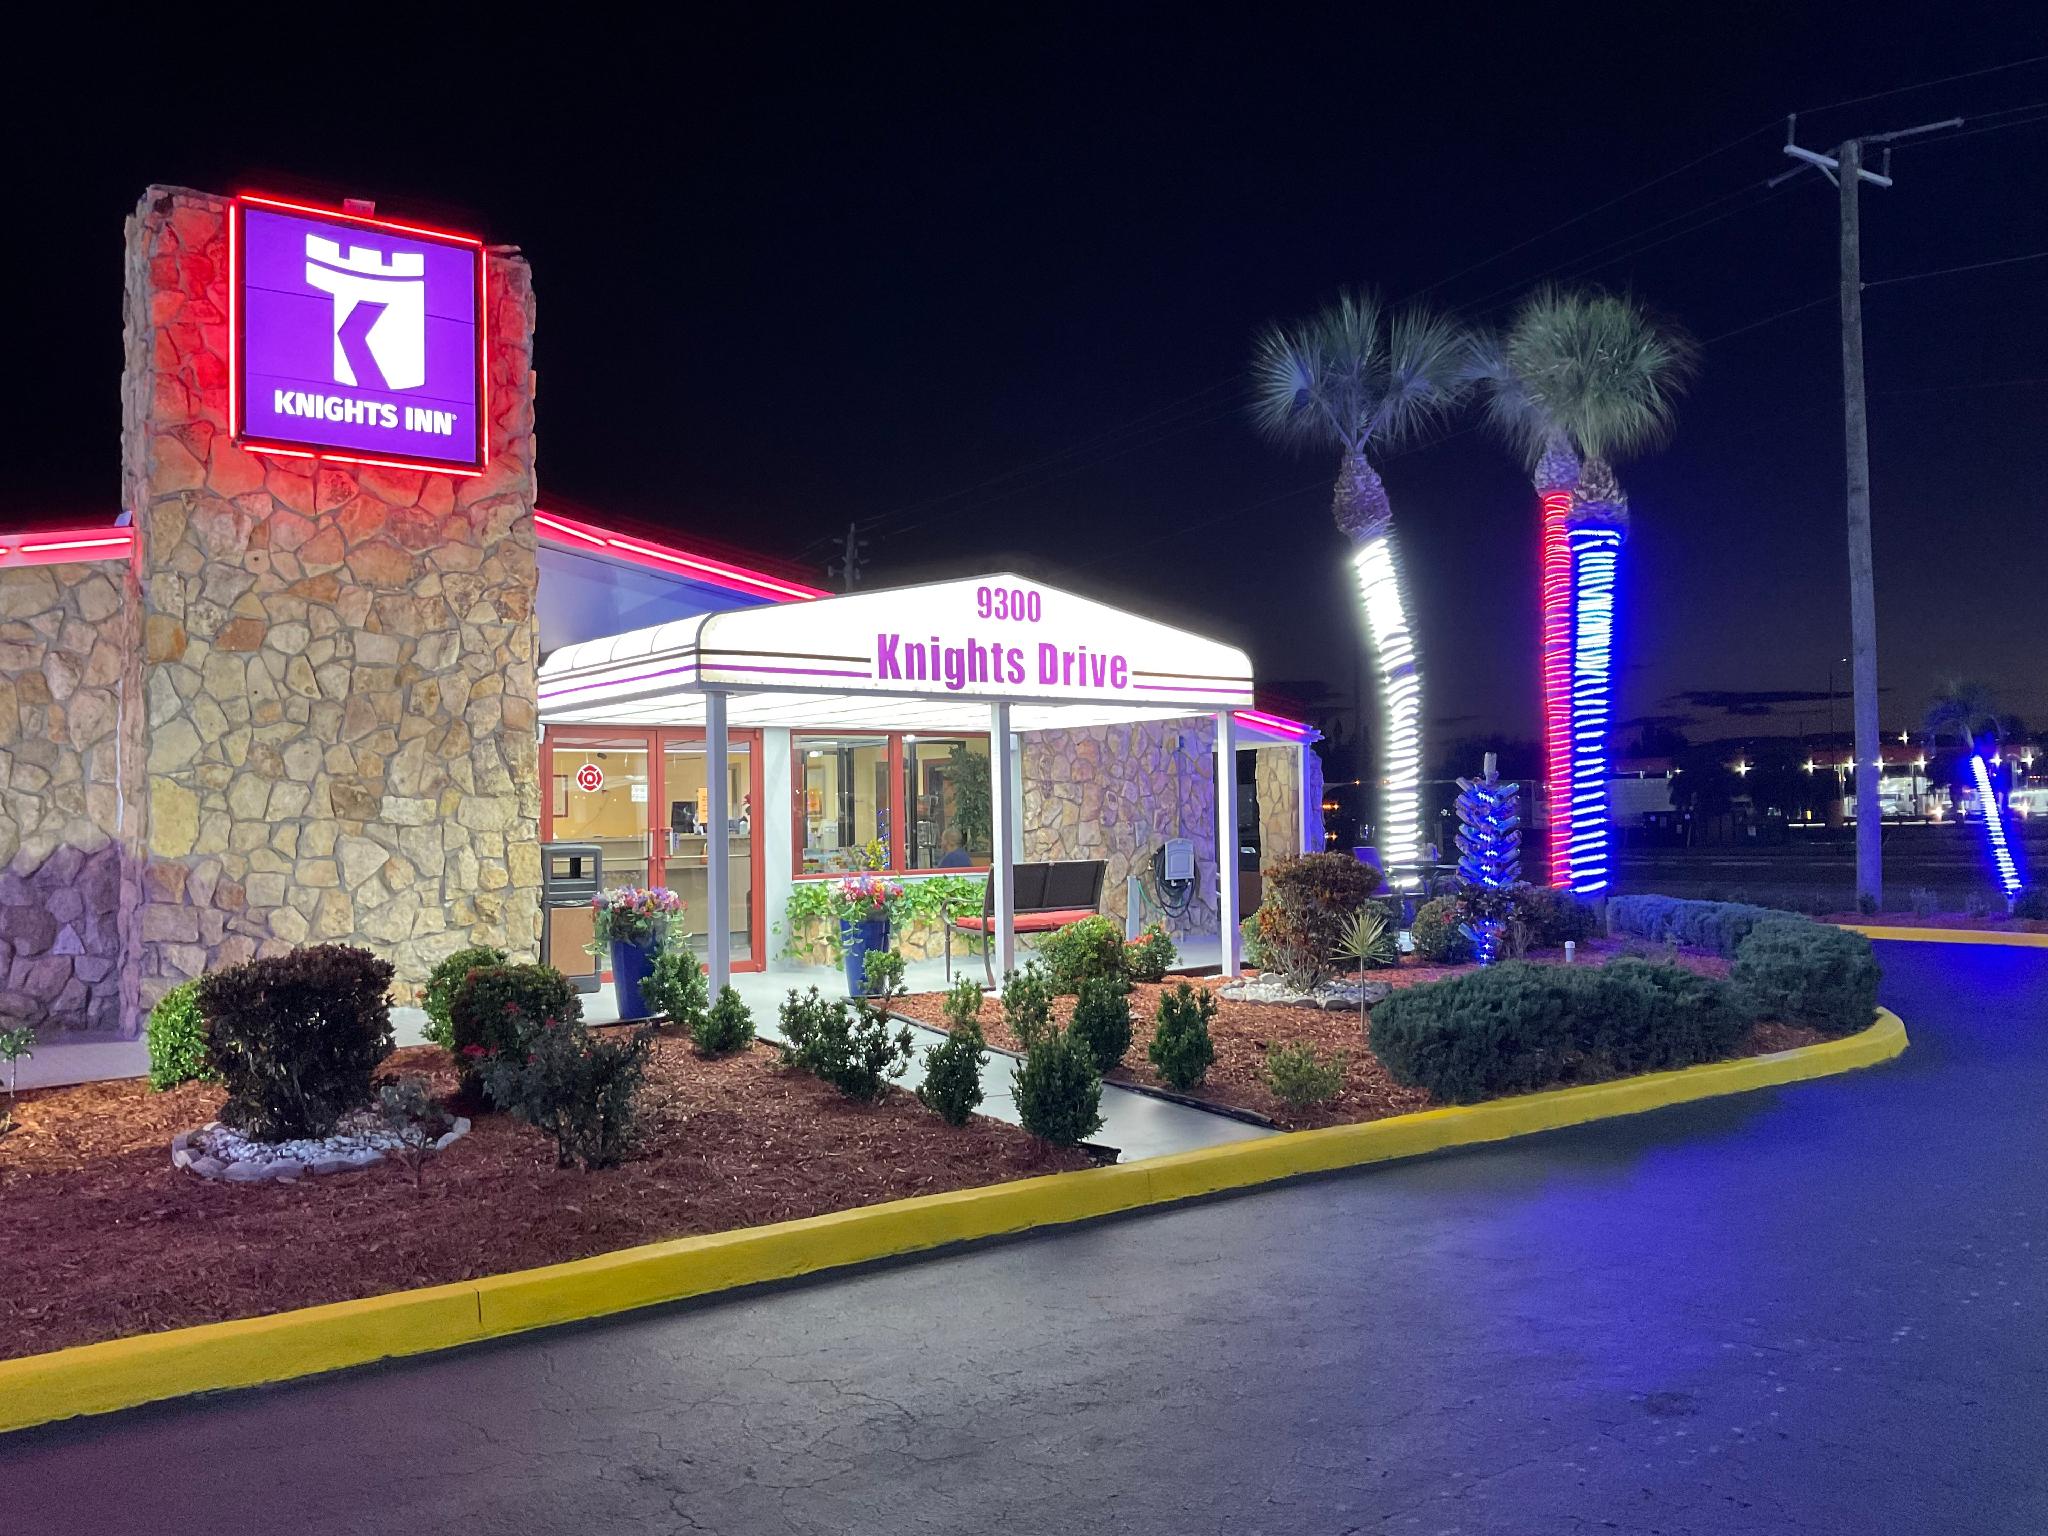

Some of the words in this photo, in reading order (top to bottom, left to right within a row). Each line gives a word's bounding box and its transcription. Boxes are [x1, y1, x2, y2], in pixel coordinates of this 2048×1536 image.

[274, 389, 399, 429] KNIGHTS
[977, 586, 1041, 623] 9300
[877, 633, 1026, 691] Knights
[1038, 643, 1129, 690] Drive
